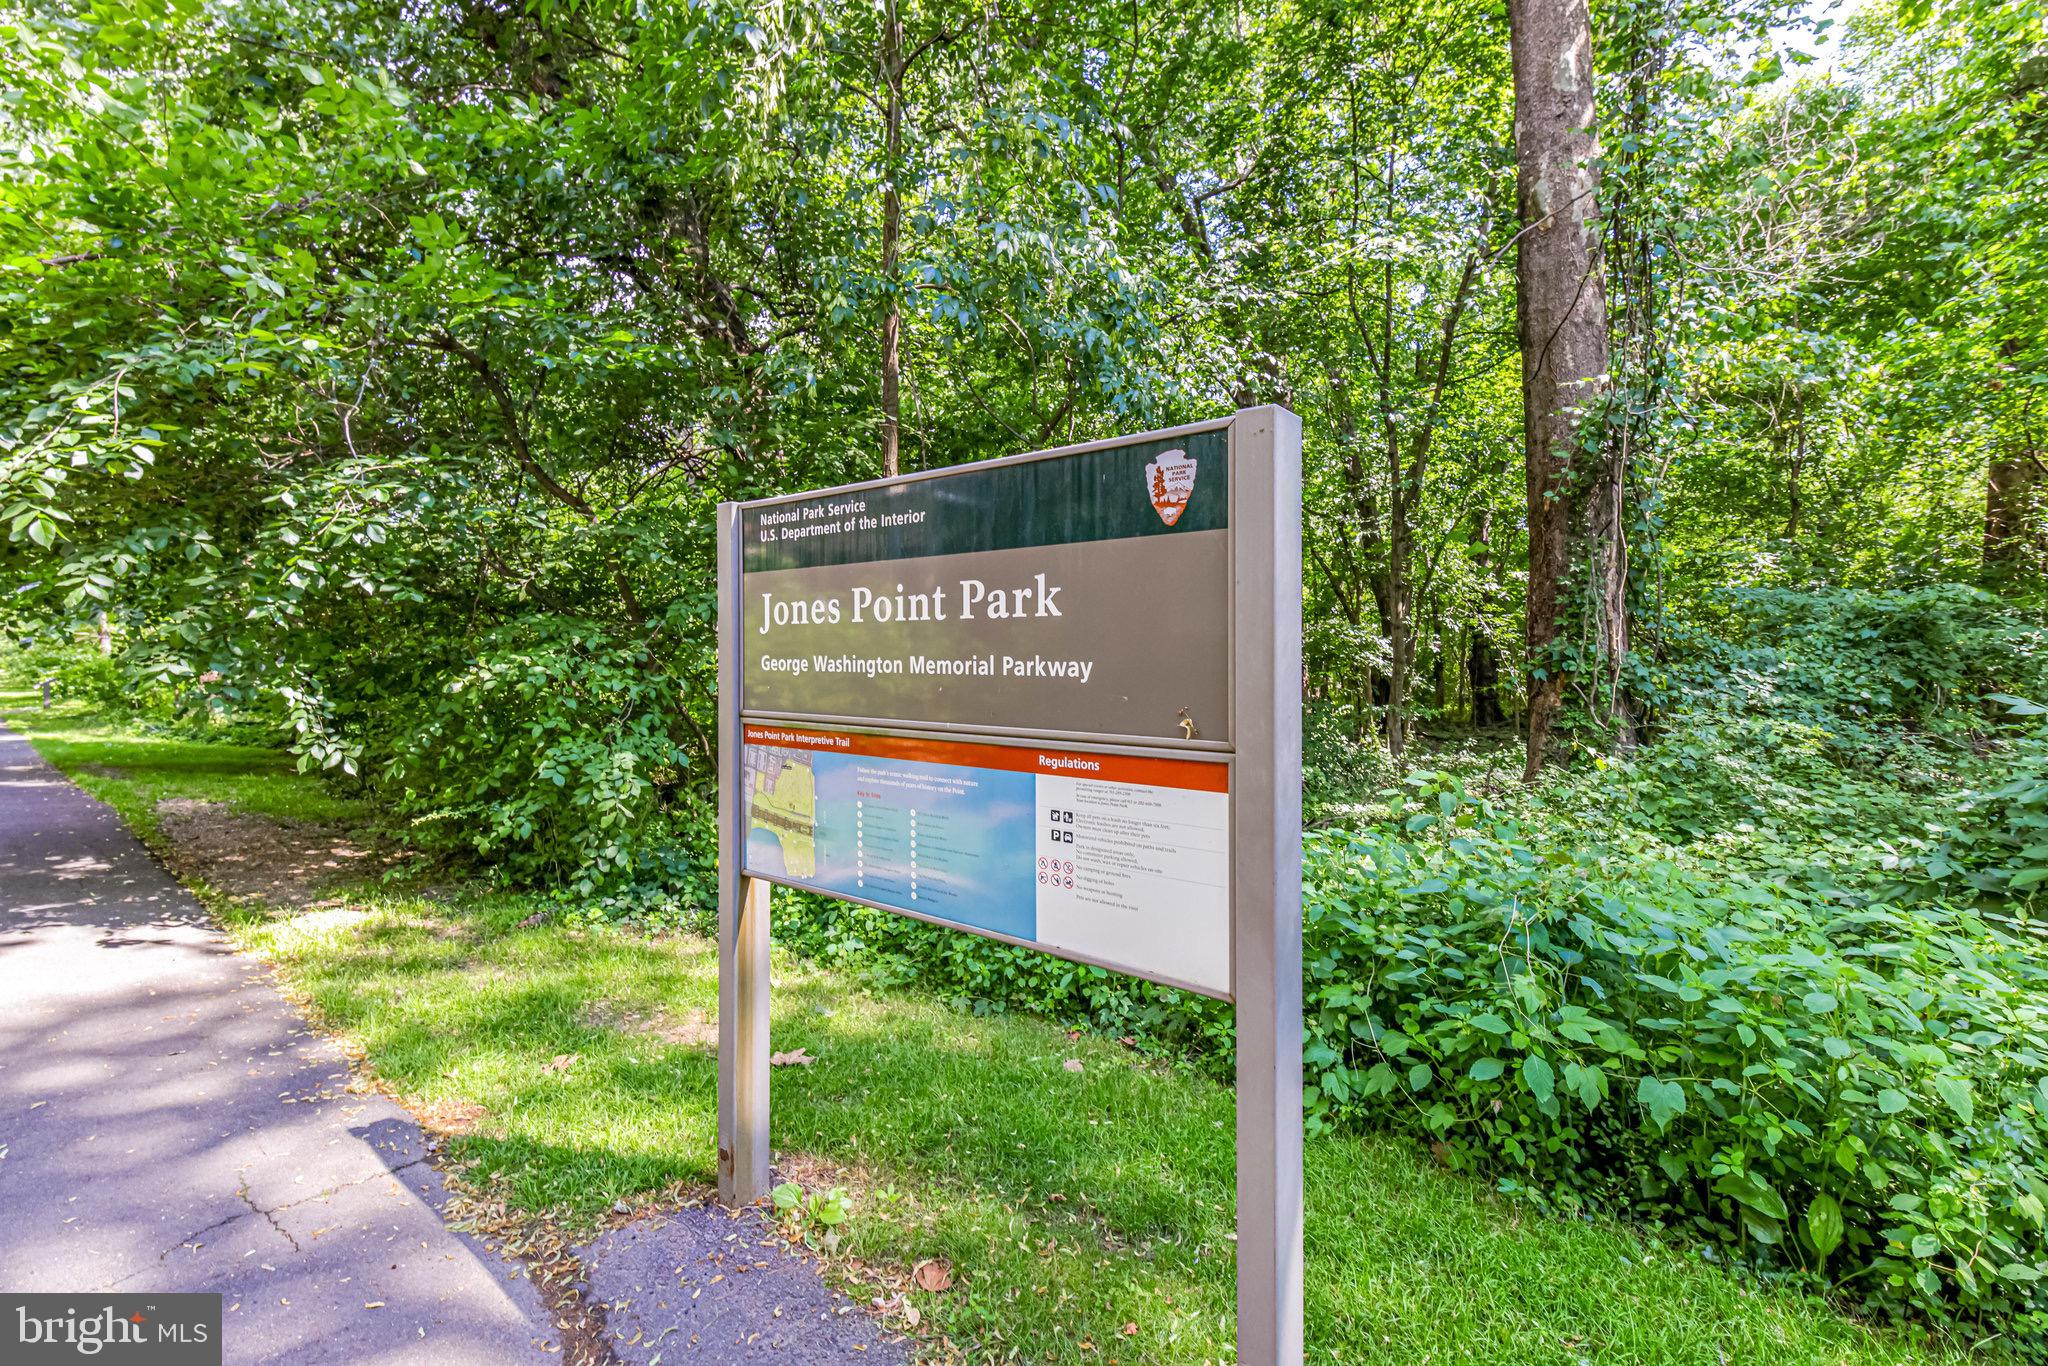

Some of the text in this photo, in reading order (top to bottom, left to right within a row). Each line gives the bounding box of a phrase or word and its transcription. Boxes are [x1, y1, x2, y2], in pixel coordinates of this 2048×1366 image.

[760, 500, 866, 526] National Park Service
[760, 509, 926, 542] U.S. Department of the Interior
[759, 573, 1063, 635] Jones Point Park
[761, 654, 1094, 683] George Washington Memorial Parkway
[748, 730, 850, 747] Jones Point Park Interpretive Trail
[1039, 755, 1100, 771] Regulations
